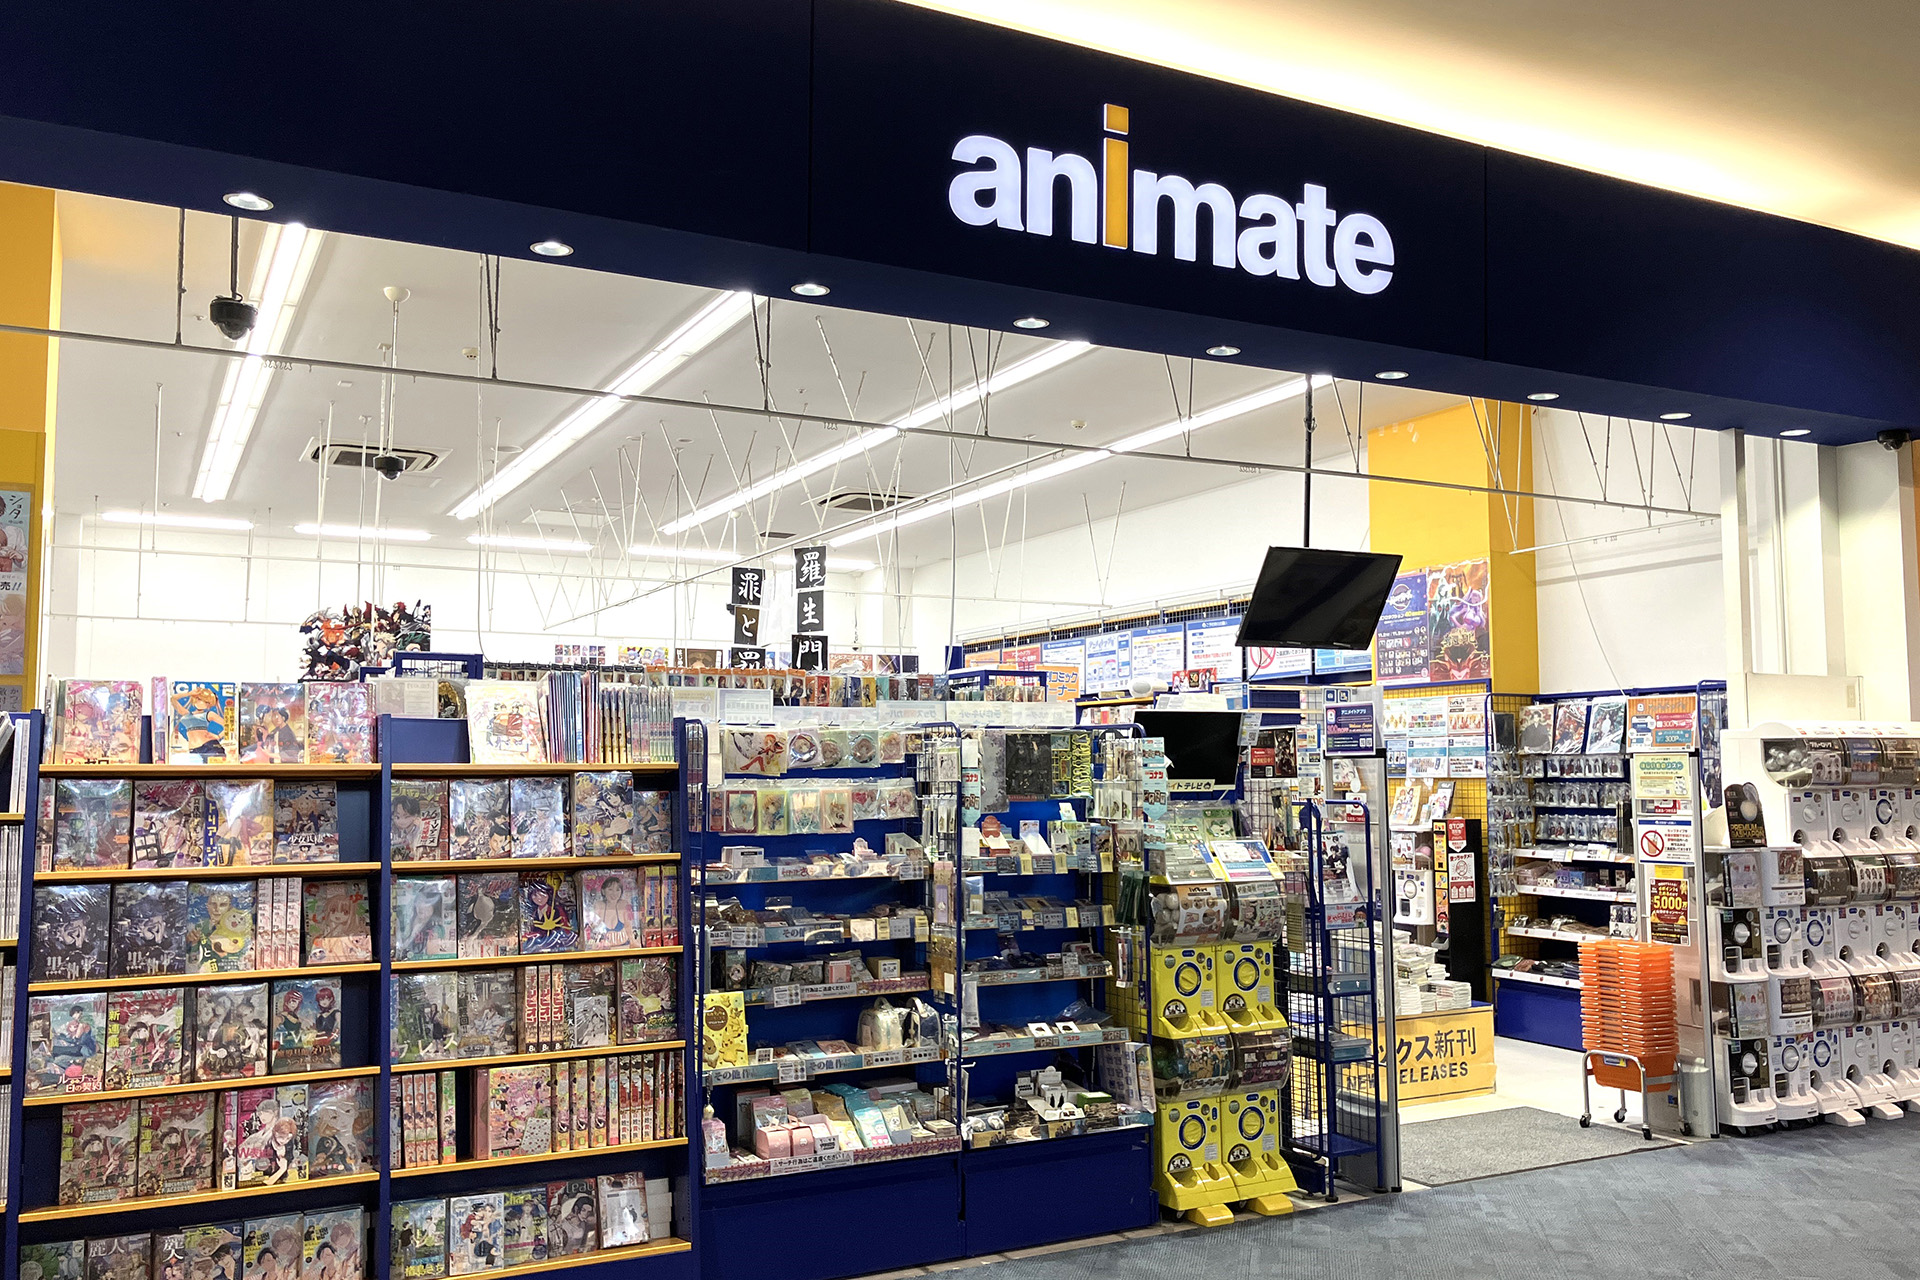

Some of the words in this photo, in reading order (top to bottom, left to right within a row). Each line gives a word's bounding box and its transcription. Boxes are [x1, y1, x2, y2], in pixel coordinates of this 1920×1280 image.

[949, 103, 1395, 294] animate
[733, 572, 762, 669] 罪と罰
[797, 551, 825, 670] 羅生門
[1048, 671, 1078, 683] コミック
[206, 802, 218, 867] トリアージX
[1399, 1061, 1469, 1085] ELEASES
[89, 1238, 125, 1257] 麗人
[163, 1236, 185, 1262] 麗人
